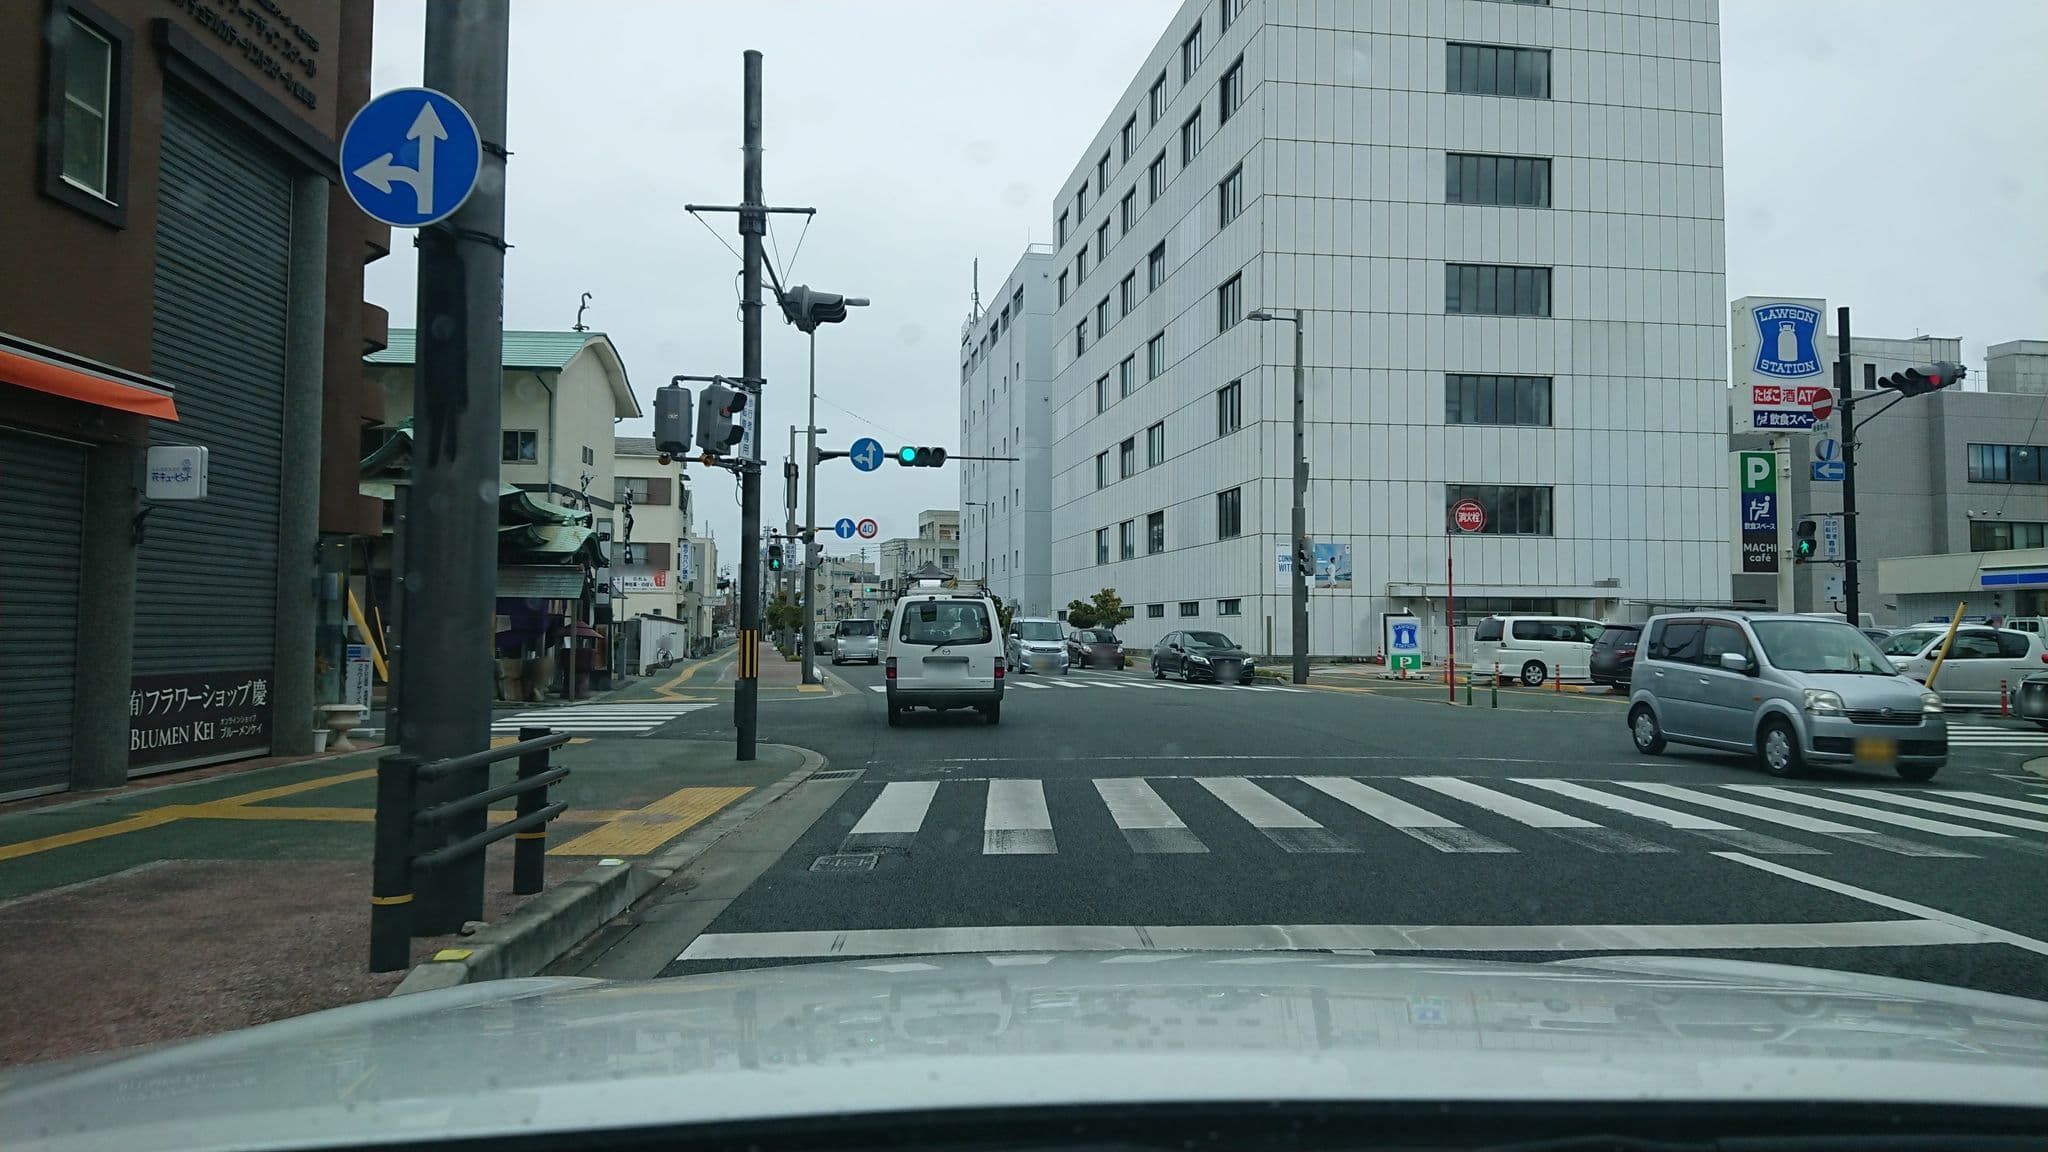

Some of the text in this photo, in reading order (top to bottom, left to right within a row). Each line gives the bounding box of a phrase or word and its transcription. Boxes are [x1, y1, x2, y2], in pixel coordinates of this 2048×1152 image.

[1758, 308, 1815, 324] LAWSON
[1760, 359, 1815, 374] STATION
[1754, 388, 1780, 402] たばこ
[1782, 389, 1796, 403] 酒
[1769, 413, 1815, 425] 飲食スペー
[1747, 457, 1770, 489] P
[862, 524, 873, 534] 40
[1744, 522, 1776, 530] 飲食スペース
[1743, 543, 1777, 553] MACHI
[1749, 553, 1772, 562] café
[1400, 656, 1412, 668] P
[129, 678, 268, 717] 有)フラワーショップ慶
[130, 721, 215, 751] BLUMEN KEI
